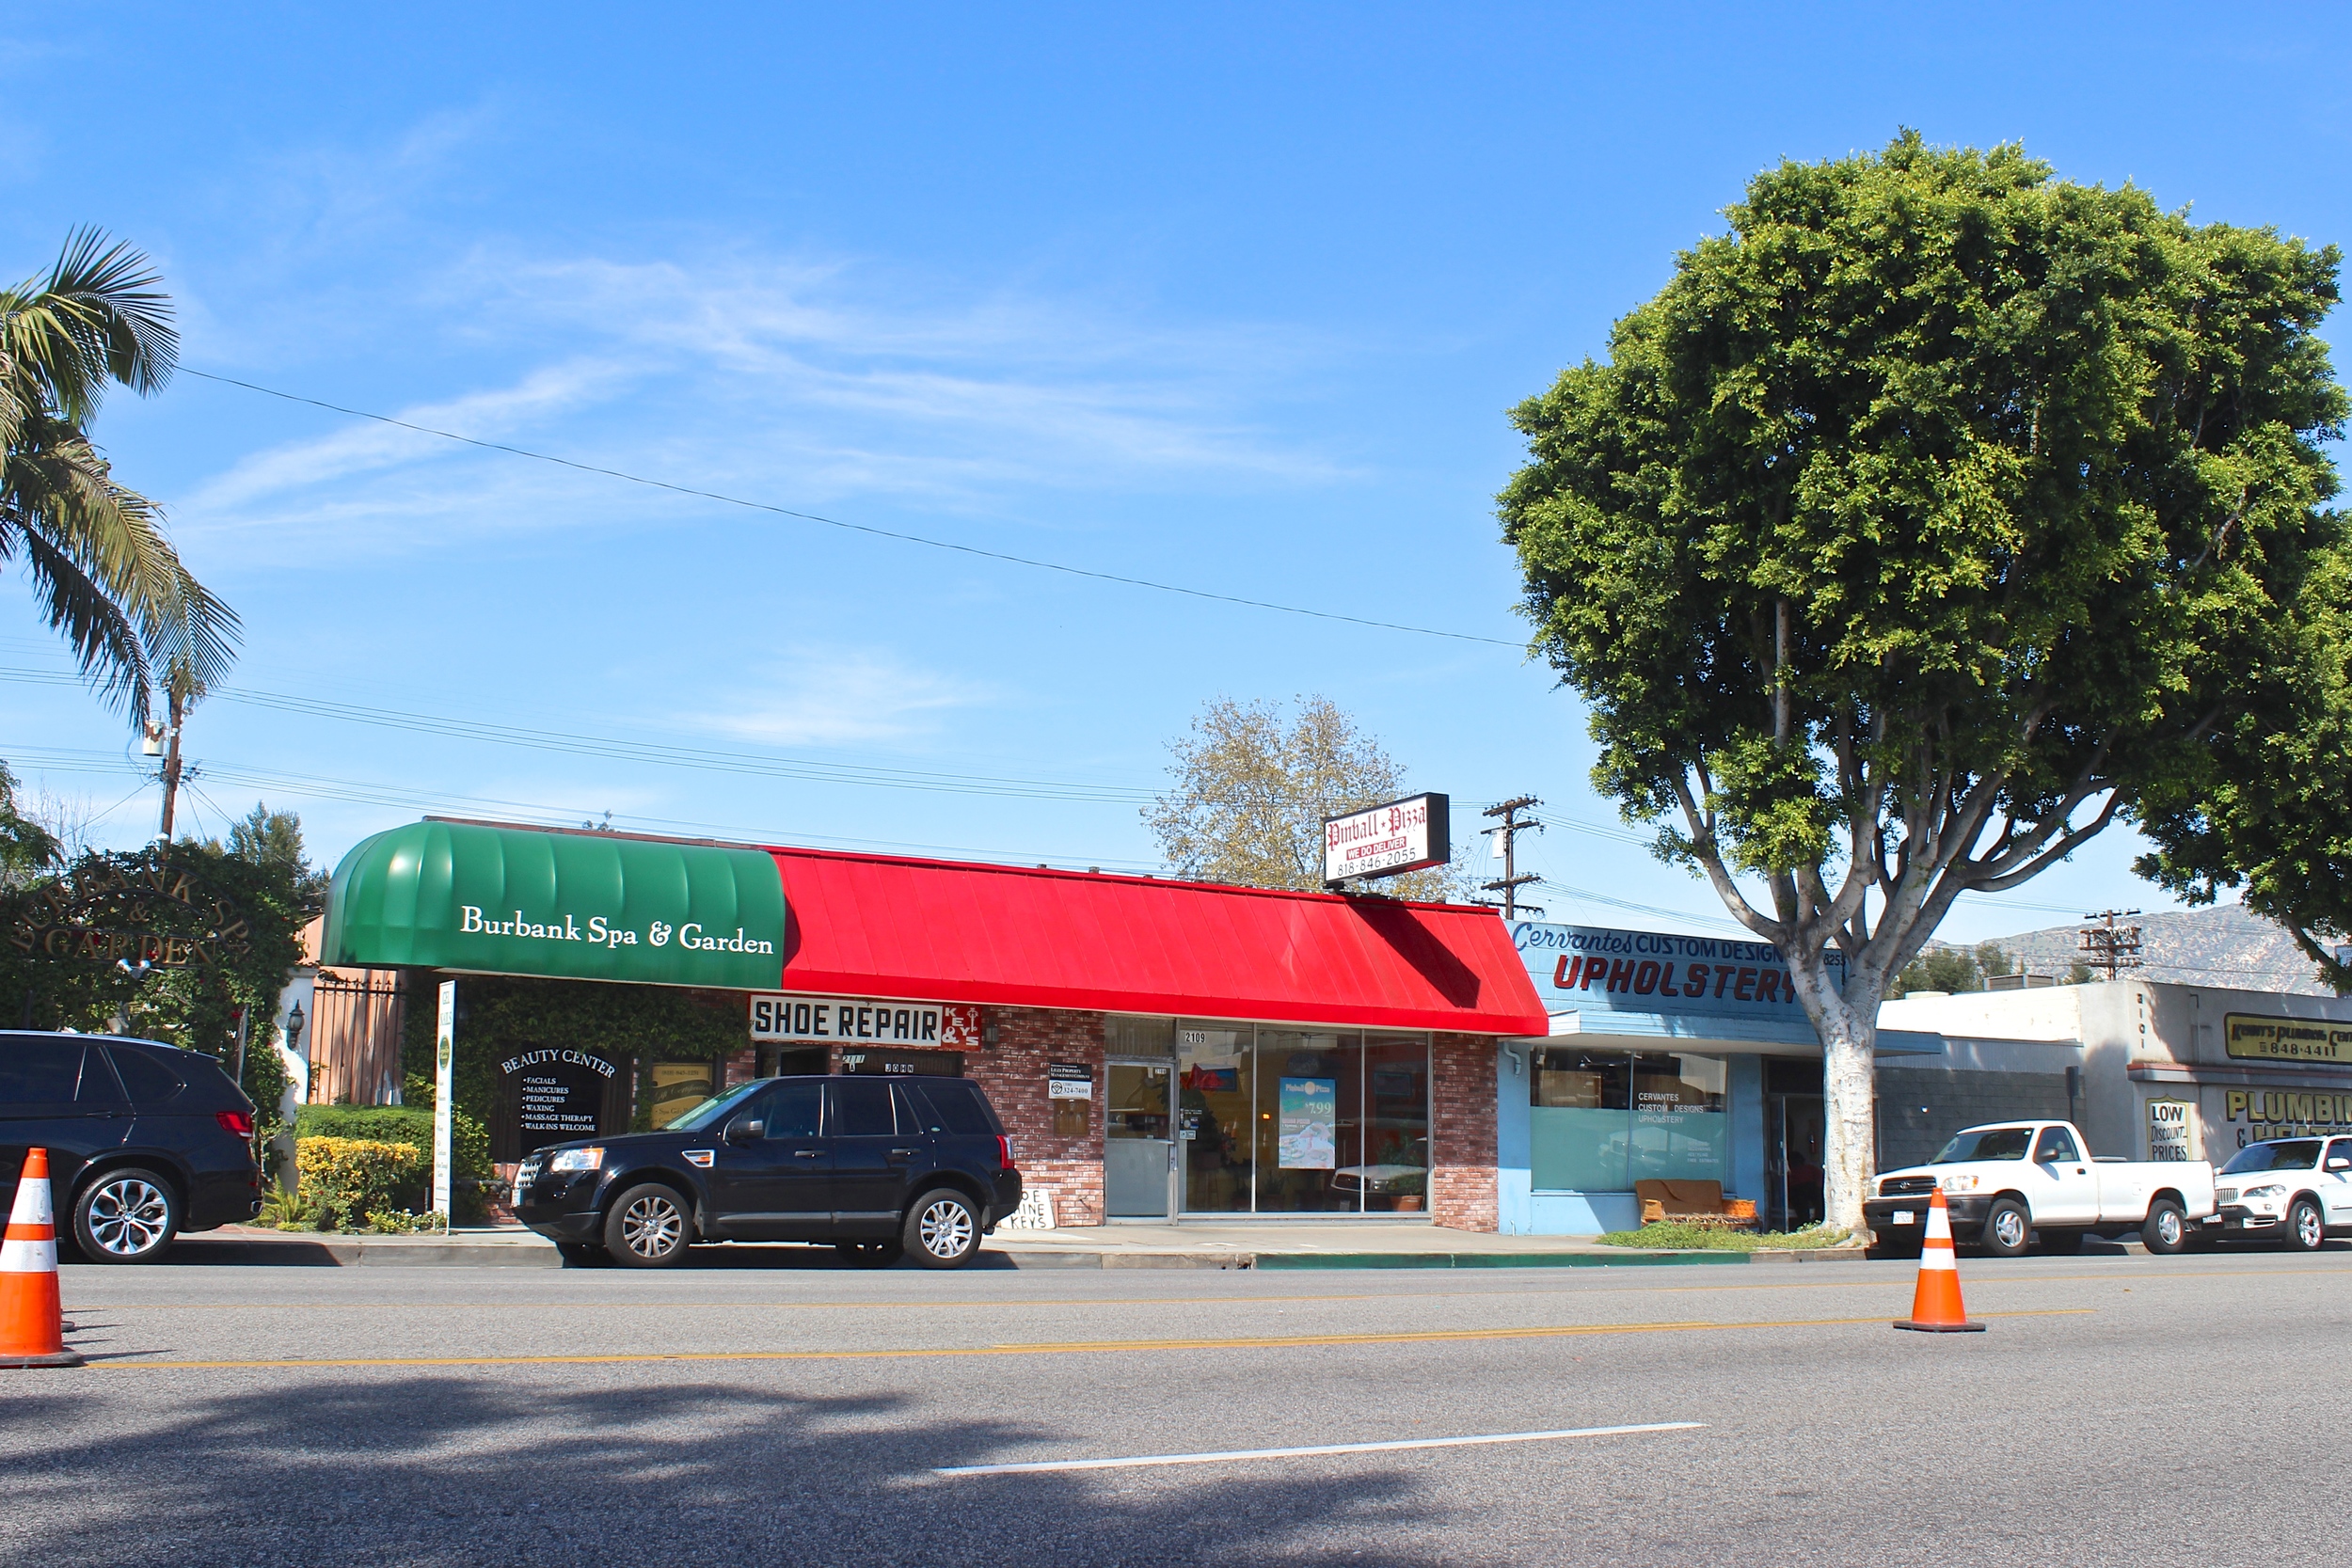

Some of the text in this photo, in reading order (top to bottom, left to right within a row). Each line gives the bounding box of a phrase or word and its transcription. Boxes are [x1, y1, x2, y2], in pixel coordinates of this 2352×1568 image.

[1327, 805, 1425, 851] Pinball Pizza
[1347, 838, 1406, 860] WE DO DELIVER
[1337, 847, 1416, 877] 818-846-2055
[9, 863, 253, 956] BURBANK SPA
[129, 900, 151, 924] &
[459, 905, 774, 955] Burbank Spa & Garden
[44, 928, 216, 965] GARDEN
[1512, 922, 1633, 954] Cervantes
[1636, 934, 1716, 958] CUSTOM
[1553, 954, 1795, 1005] UPHOLSTERY
[755, 1001, 938, 1041] SHOE REPAIR
[945, 1007, 979, 1046] KEYS
[941, 1026, 960, 1044] &
[1185, 1032, 1205, 1043] 2109
[501, 1049, 616, 1079] BEAUTY CENTER
[885, 1064, 914, 1072] JOHN
[1638, 1092, 1679, 1101] CERVANTES
[1305, 1101, 1332, 1115] $7.99
[1638, 1103, 1704, 1114] CUSTOM DESIGNS
[2152, 1105, 2184, 1122] LOW
[559, 1123, 596, 1132] WELCOME
[1638, 1115, 1684, 1124] UPHOLSTERY
[2151, 1125, 2185, 1142] DISCOUNT
[2152, 1145, 2187, 1162] PRICES
[1022, 1190, 1041, 1203] OE
[1014, 1203, 1044, 1216] INE
[1010, 1215, 1047, 1230] KEYS
